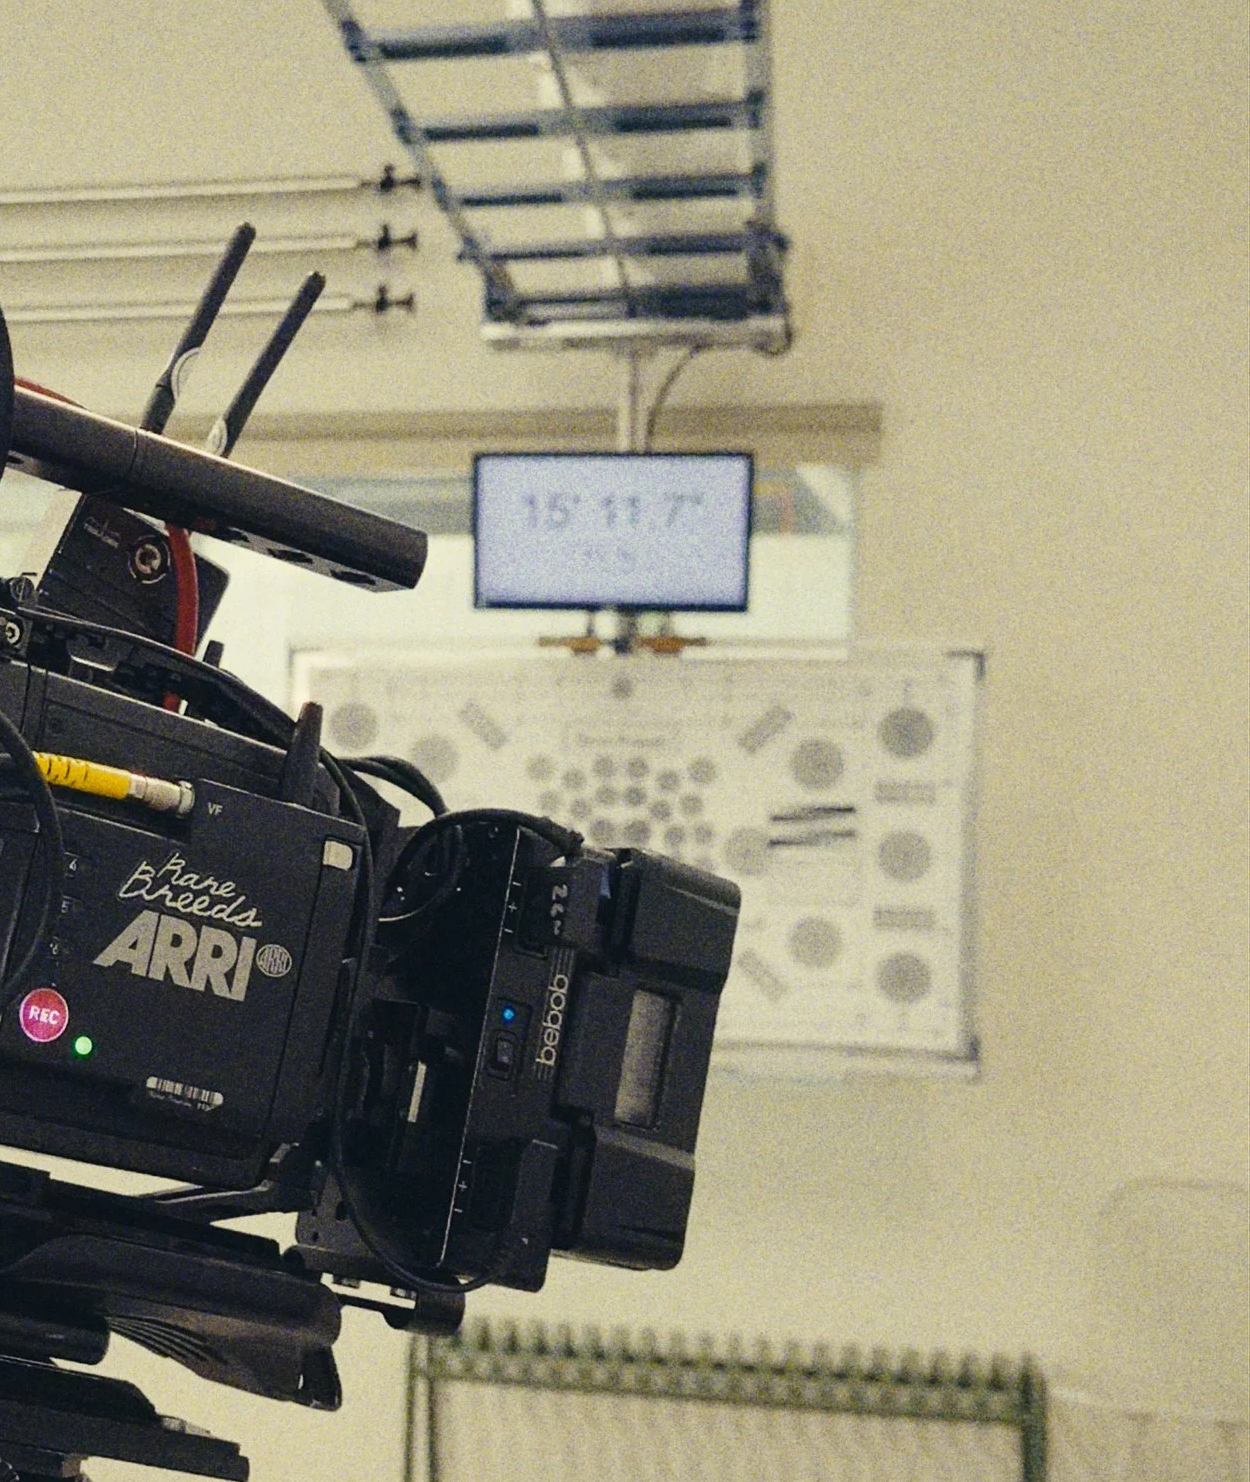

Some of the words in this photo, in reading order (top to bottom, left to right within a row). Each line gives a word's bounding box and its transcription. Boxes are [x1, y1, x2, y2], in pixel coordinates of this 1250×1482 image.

[207, 803, 223, 816] VF
[119, 861, 263, 928] Breeds
[92, 909, 257, 1002] ARRI
[29, 1006, 60, 1025] REC
[536, 974, 569, 1065] bebob
